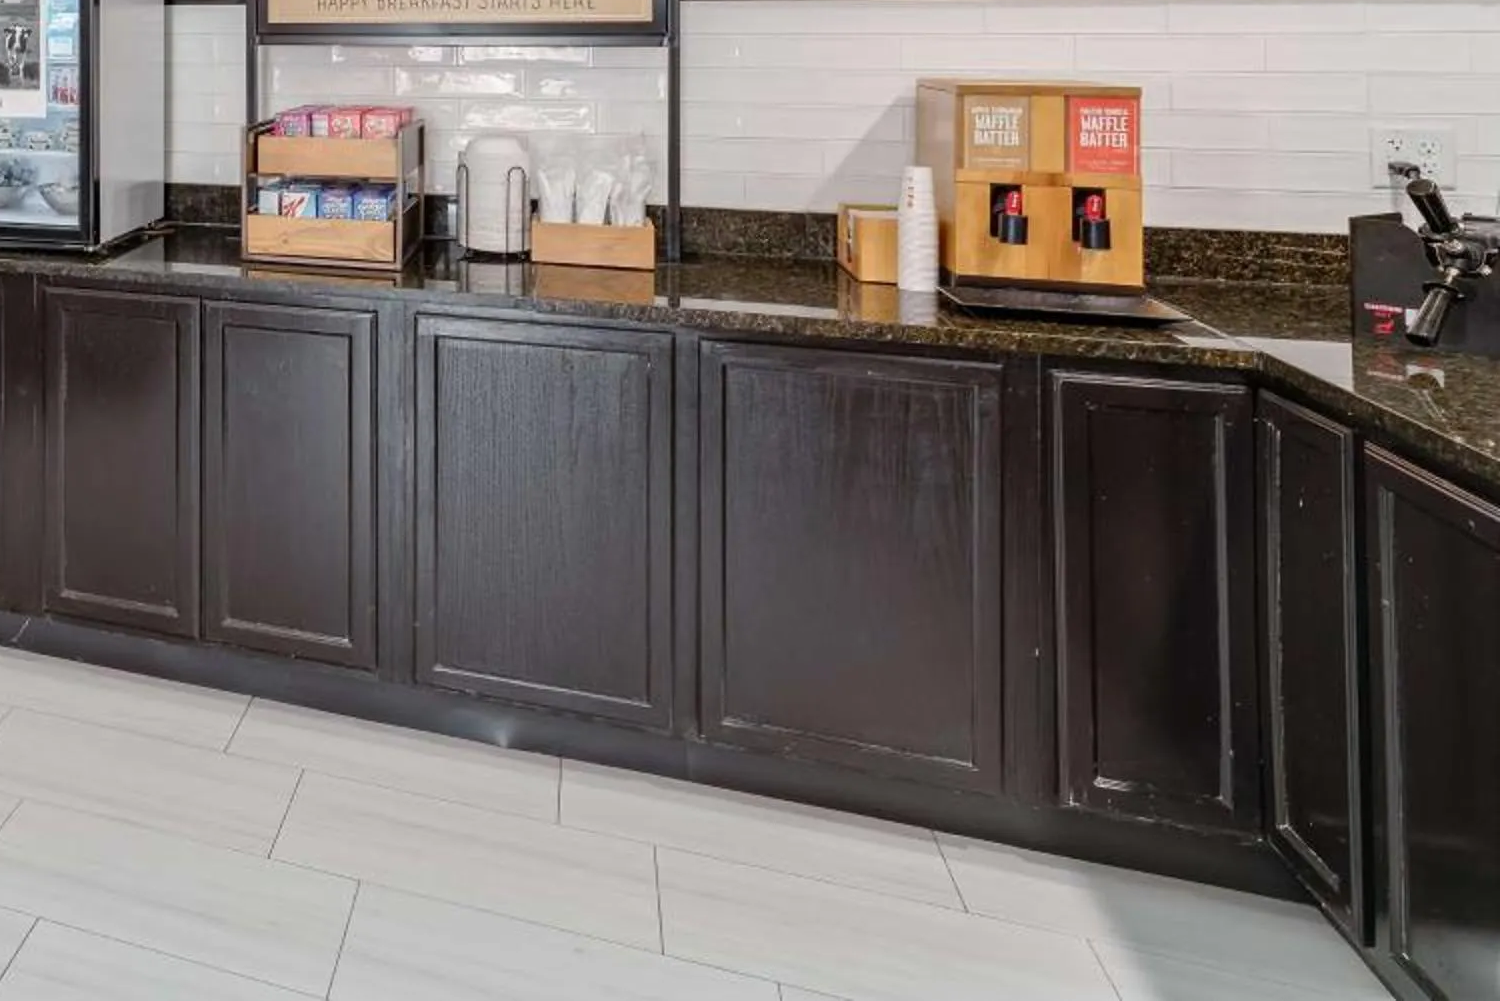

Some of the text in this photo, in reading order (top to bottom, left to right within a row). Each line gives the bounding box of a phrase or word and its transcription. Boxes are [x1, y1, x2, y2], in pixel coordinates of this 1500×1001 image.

[975, 114, 1019, 130] WAFFLE
[1081, 114, 1129, 132] WAFFLE
[974, 130, 1019, 147] BATTER
[1080, 131, 1128, 149] BATTER
